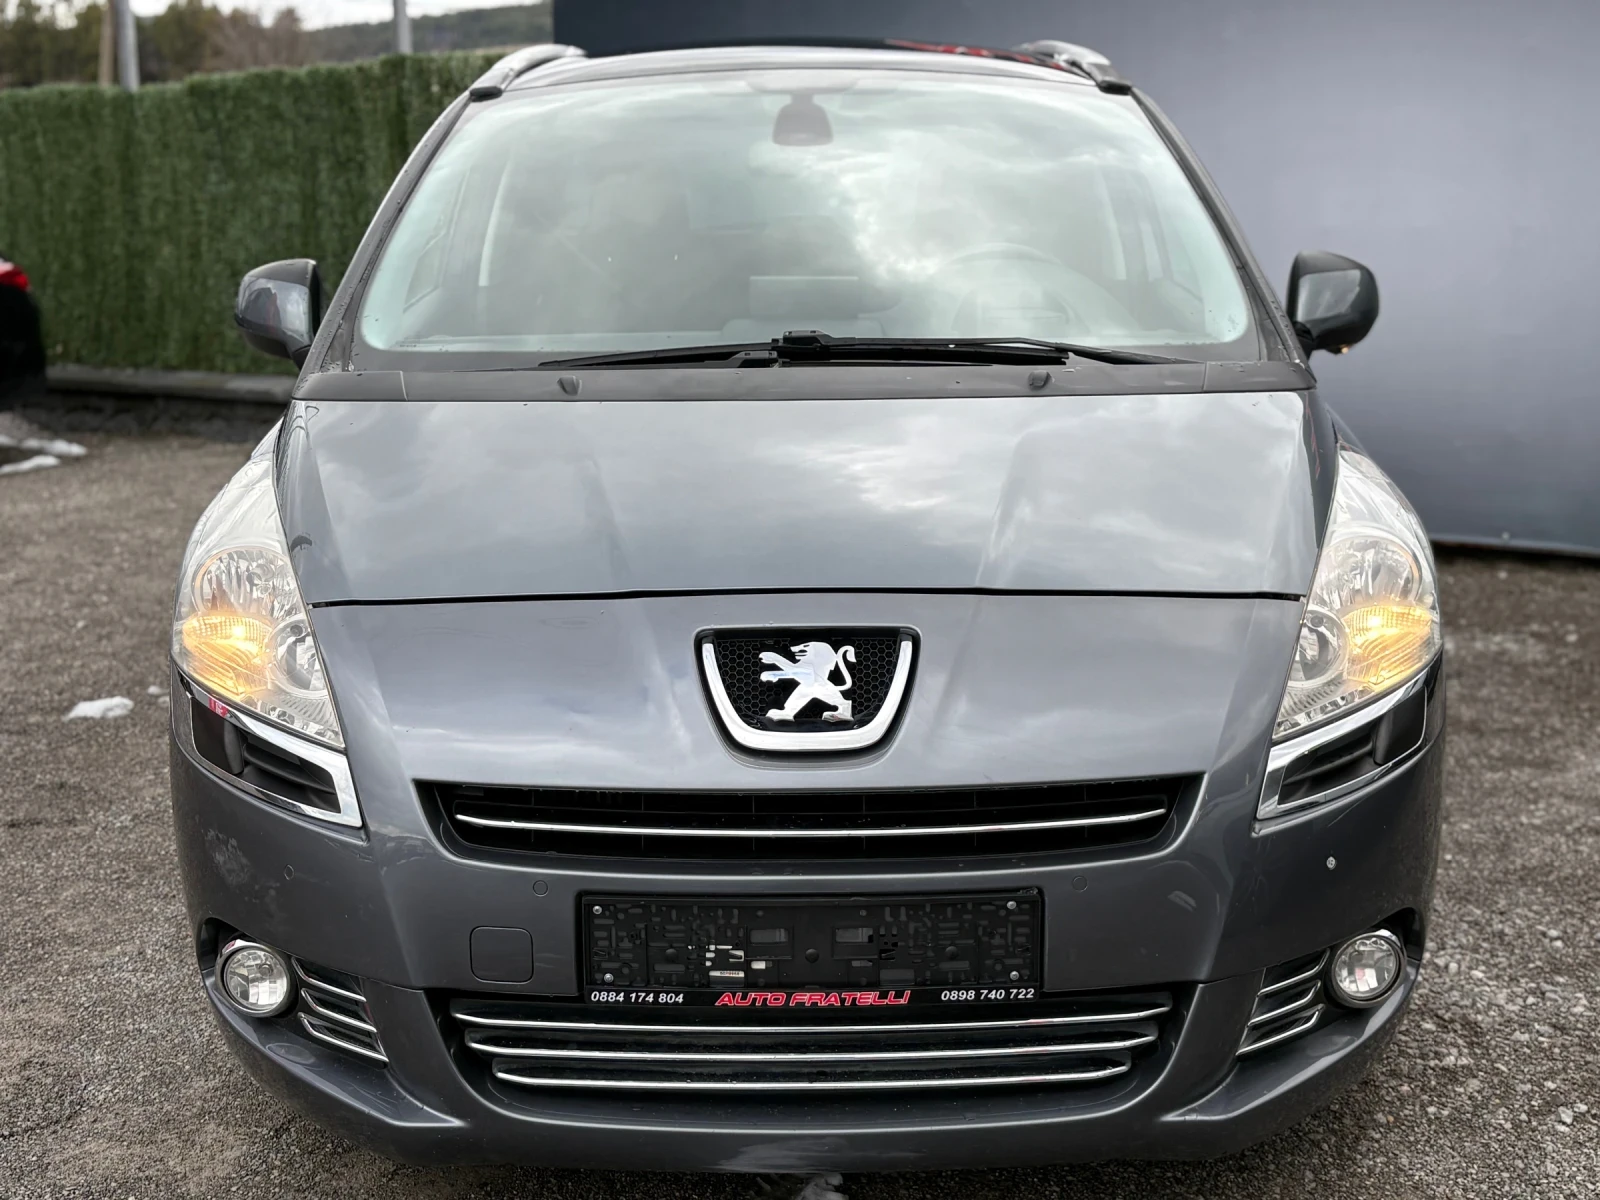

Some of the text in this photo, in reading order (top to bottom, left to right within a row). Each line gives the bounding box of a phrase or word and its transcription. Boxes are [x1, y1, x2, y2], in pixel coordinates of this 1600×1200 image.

[590, 991, 684, 1003] 0884 174 804
[715, 990, 911, 1006] AUTO FRATELLI
[941, 988, 1035, 1001] 0898 740 722
